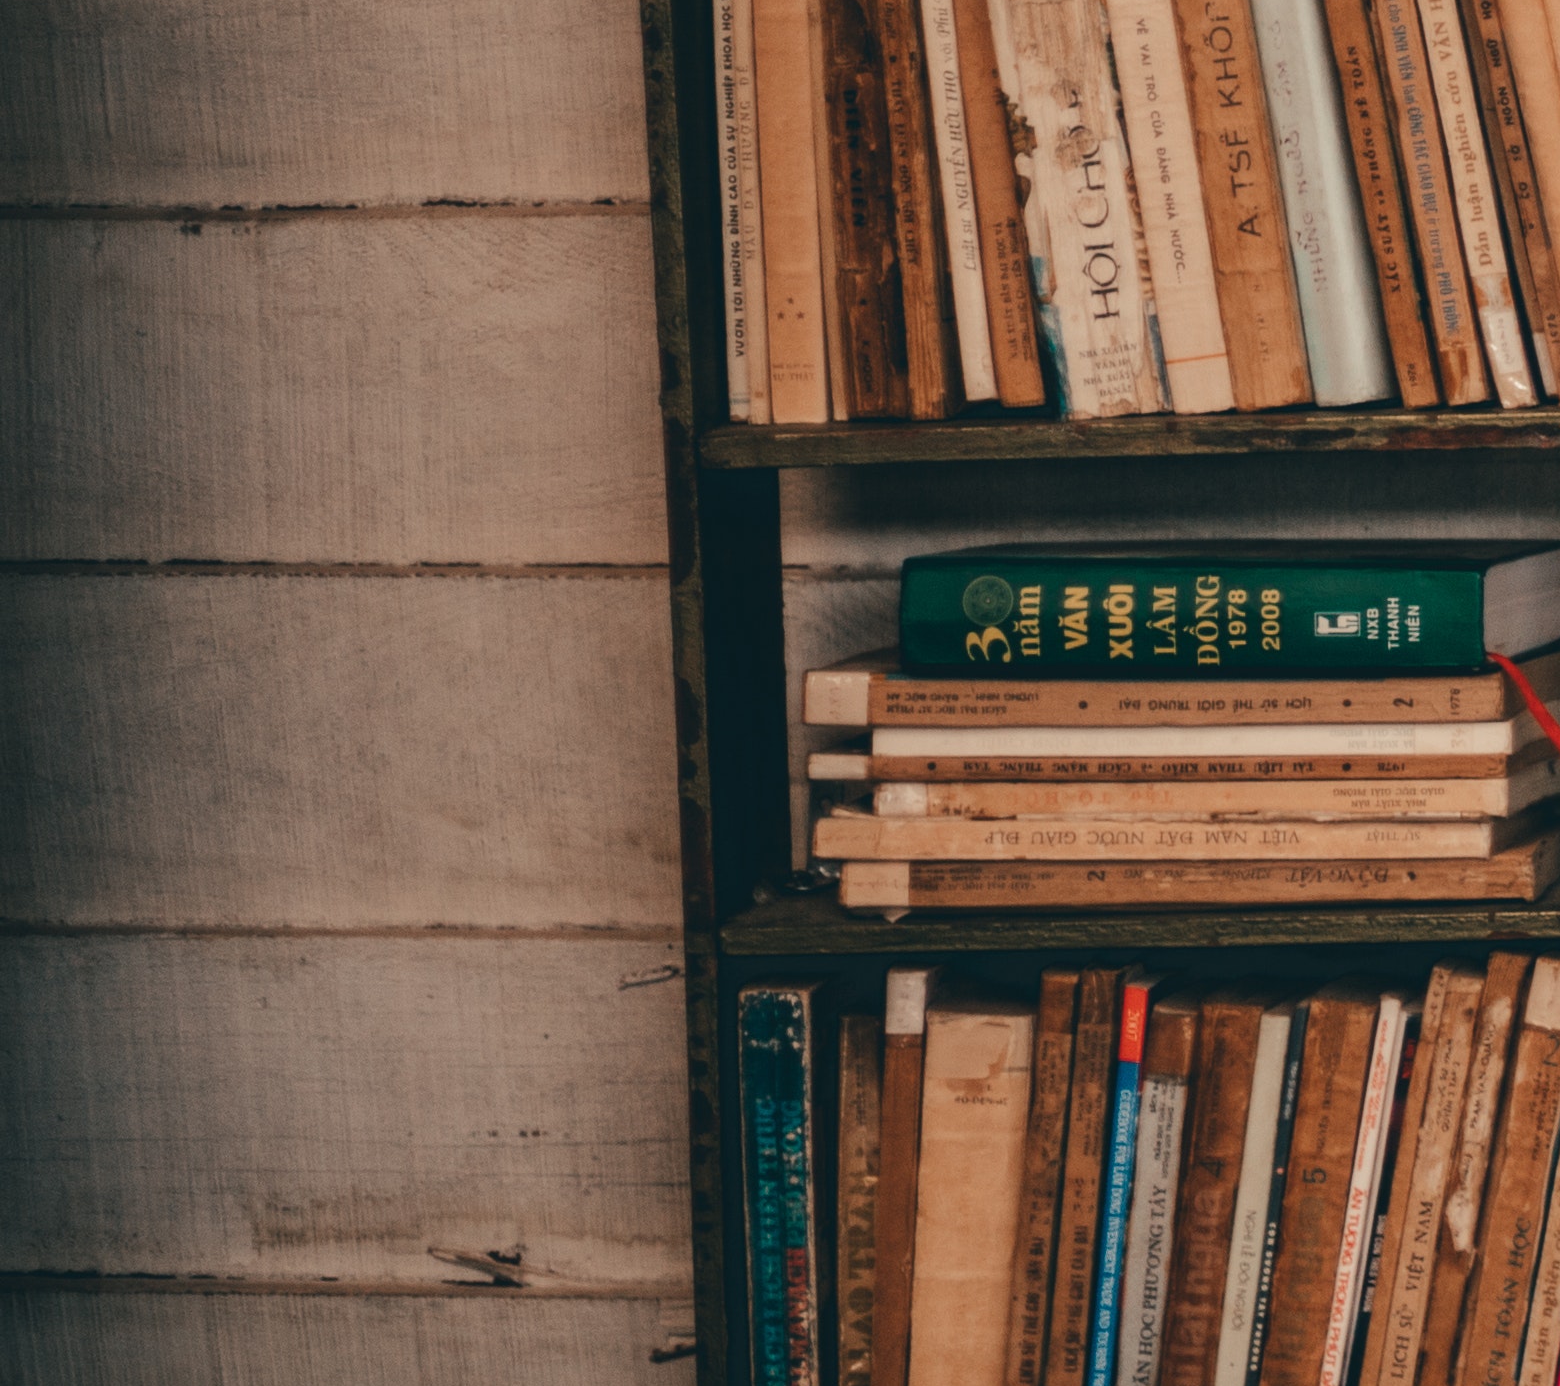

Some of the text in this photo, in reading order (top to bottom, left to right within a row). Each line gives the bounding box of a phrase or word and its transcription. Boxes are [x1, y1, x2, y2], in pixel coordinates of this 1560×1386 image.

[721, 35, 733, 70] KHOA
[1137, 42, 1152, 66] VAI
[727, 174, 738, 199] CAO
[1011, 583, 1041, 656] năm
[1057, 585, 1089, 650] VĂN
[1102, 583, 1134, 658] XUÔI
[1145, 584, 1177, 655] LÂM
[1182, 574, 1220, 665] ĐỒNG
[1226, 588, 1247, 649] 1978
[1260, 588, 1280, 650] 2008
[1365, 607, 1379, 640] NXB
[1386, 596, 1400, 649] THANH
[1404, 604, 1421, 642] NIÊN
[1123, 1008, 1140, 1042] 2007
[1136, 1312, 1159, 1356] HỌC
